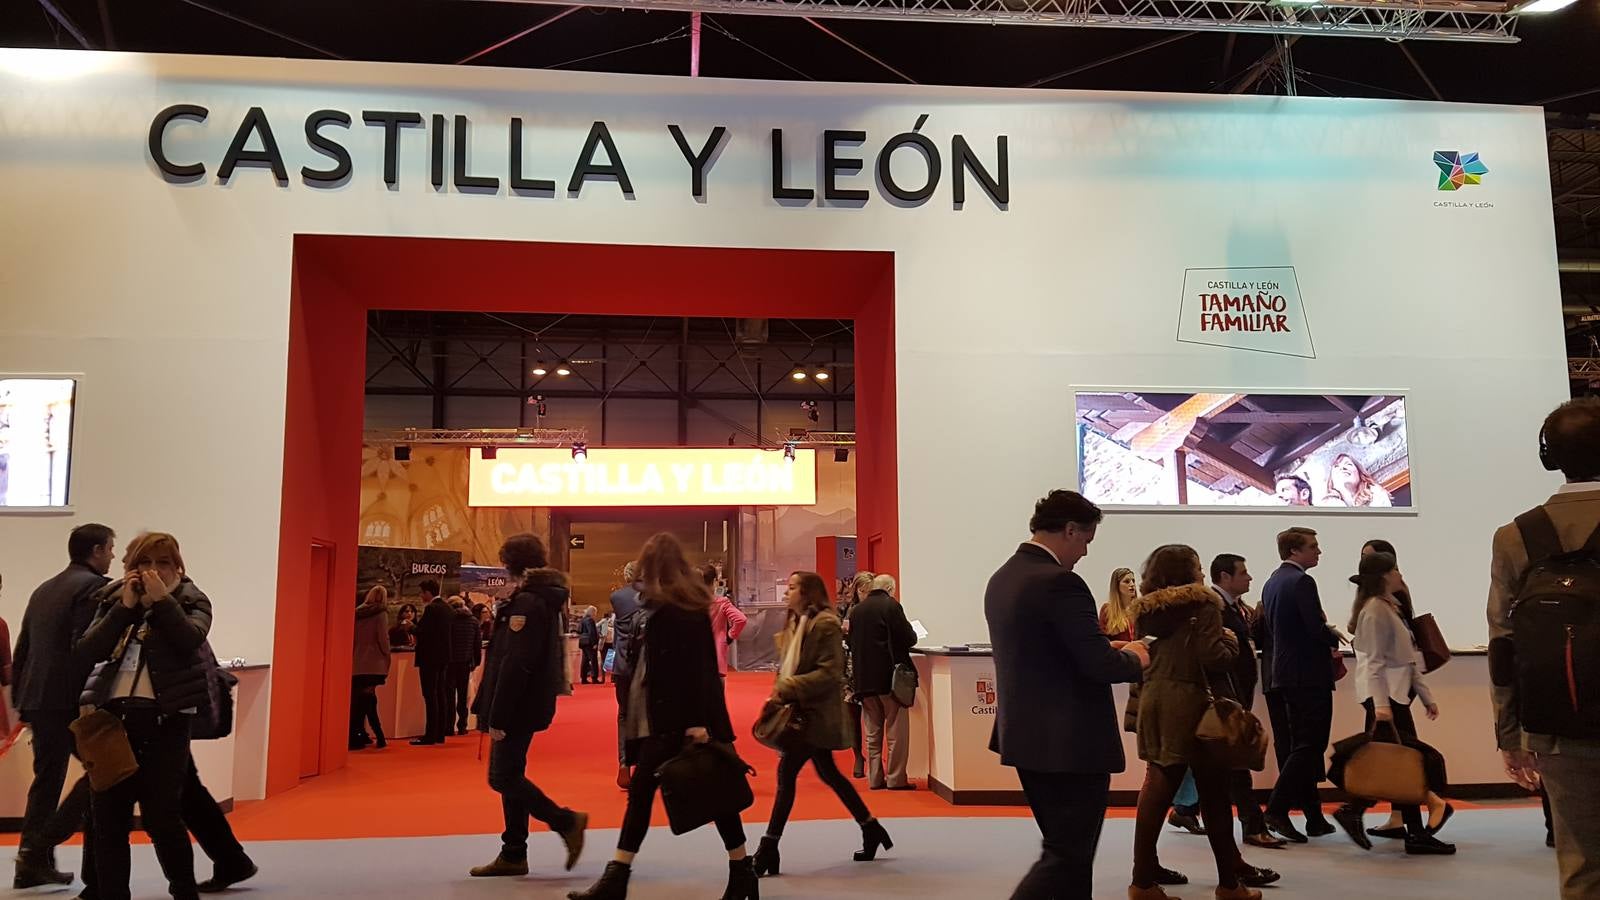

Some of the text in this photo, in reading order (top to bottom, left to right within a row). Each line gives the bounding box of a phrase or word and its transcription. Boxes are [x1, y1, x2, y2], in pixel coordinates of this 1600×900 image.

[148, 94, 1010, 207] CASTILLA Y LEÓN
[1207, 281, 1248, 289] CASTILLA
[1256, 280, 1279, 290] LEÓN
[1198, 291, 1287, 312] TAMAÑO
[1200, 313, 1291, 332] FAMILIAR
[491, 454, 793, 494] CASTILLA Y LEÓN
[412, 563, 447, 574] BURGOS
[488, 577, 505, 586] LEÓN
